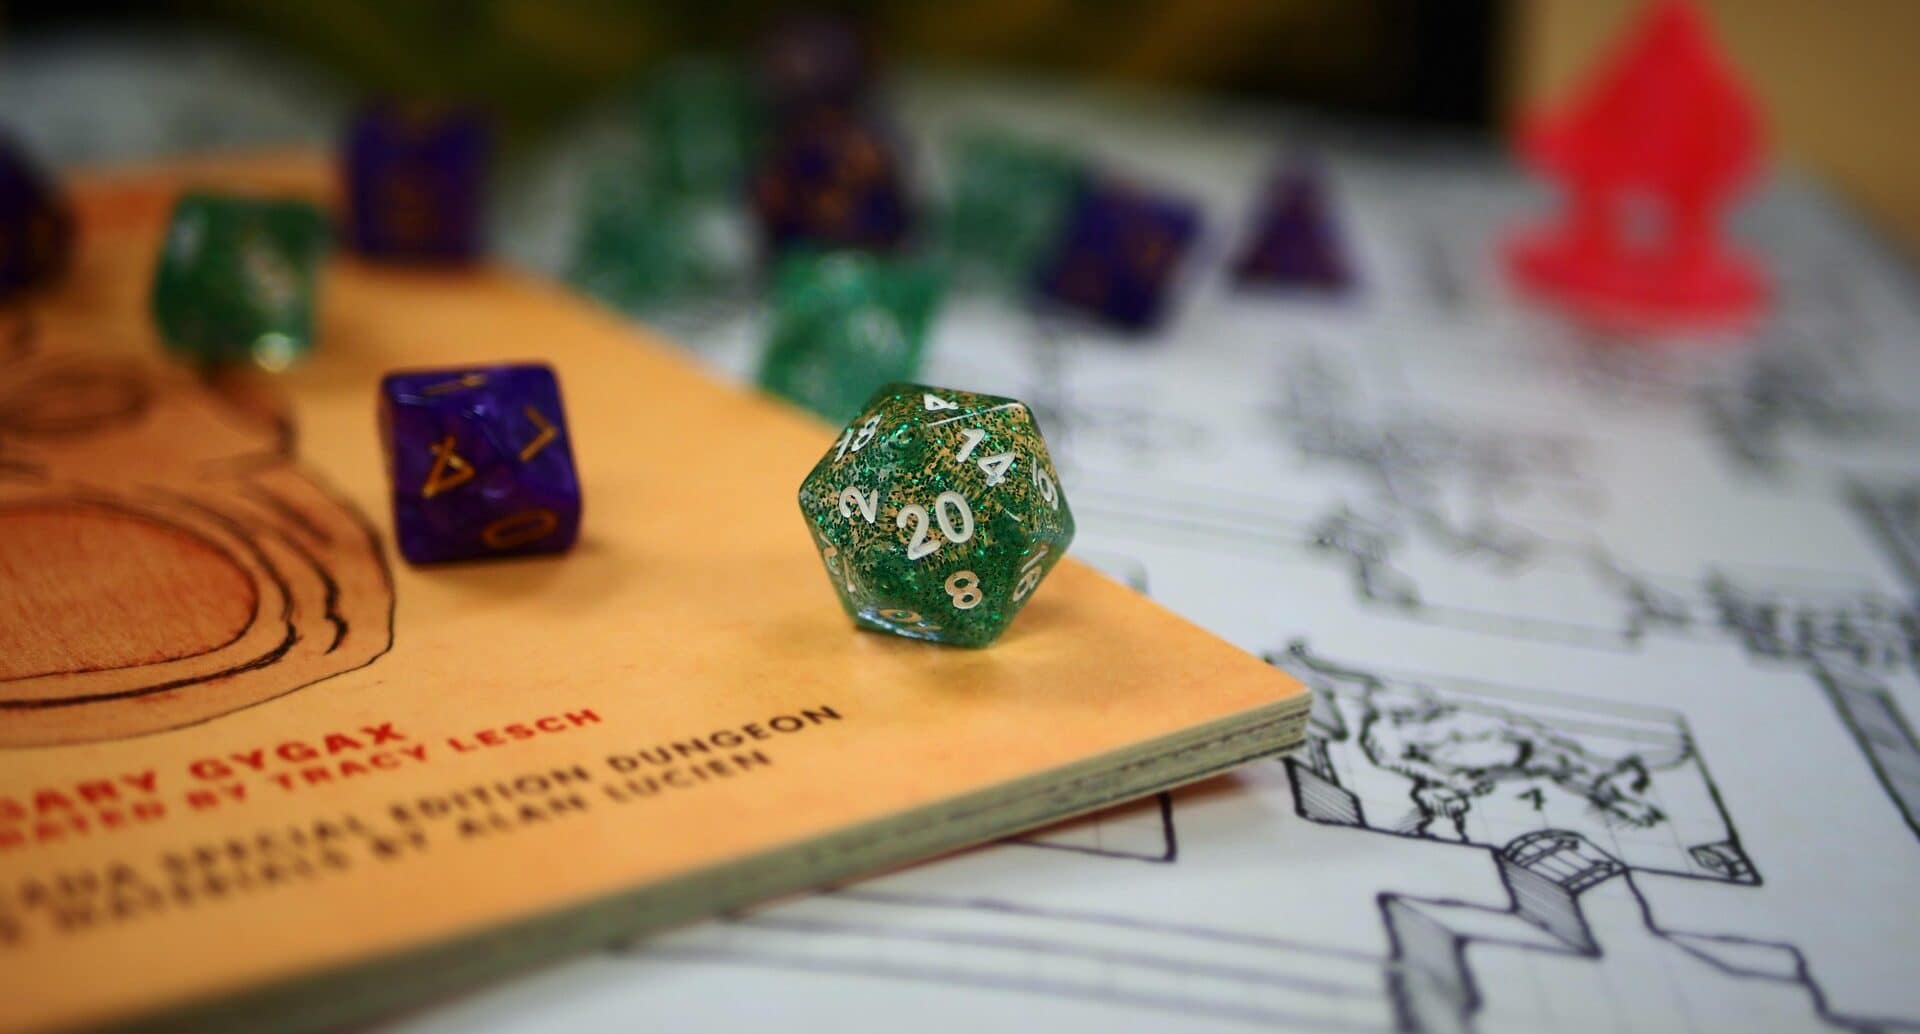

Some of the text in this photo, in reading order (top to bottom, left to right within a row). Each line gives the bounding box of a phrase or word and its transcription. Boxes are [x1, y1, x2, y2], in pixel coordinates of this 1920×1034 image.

[923, 393, 960, 411] 4
[421, 434, 477, 498] 4
[955, 427, 1017, 488] 14
[838, 485, 879, 525] 2
[896, 490, 975, 560] 20
[944, 569, 983, 610] 8
[185, 782, 250, 811] BY
[268, 744, 427, 792] TRACY
[447, 708, 602, 754] LESCH
[188, 722, 405, 781] GYGAX
[388, 764, 592, 826] EDITION
[606, 704, 843, 773] DUNGEON
[603, 749, 772, 801] LUCIEN
